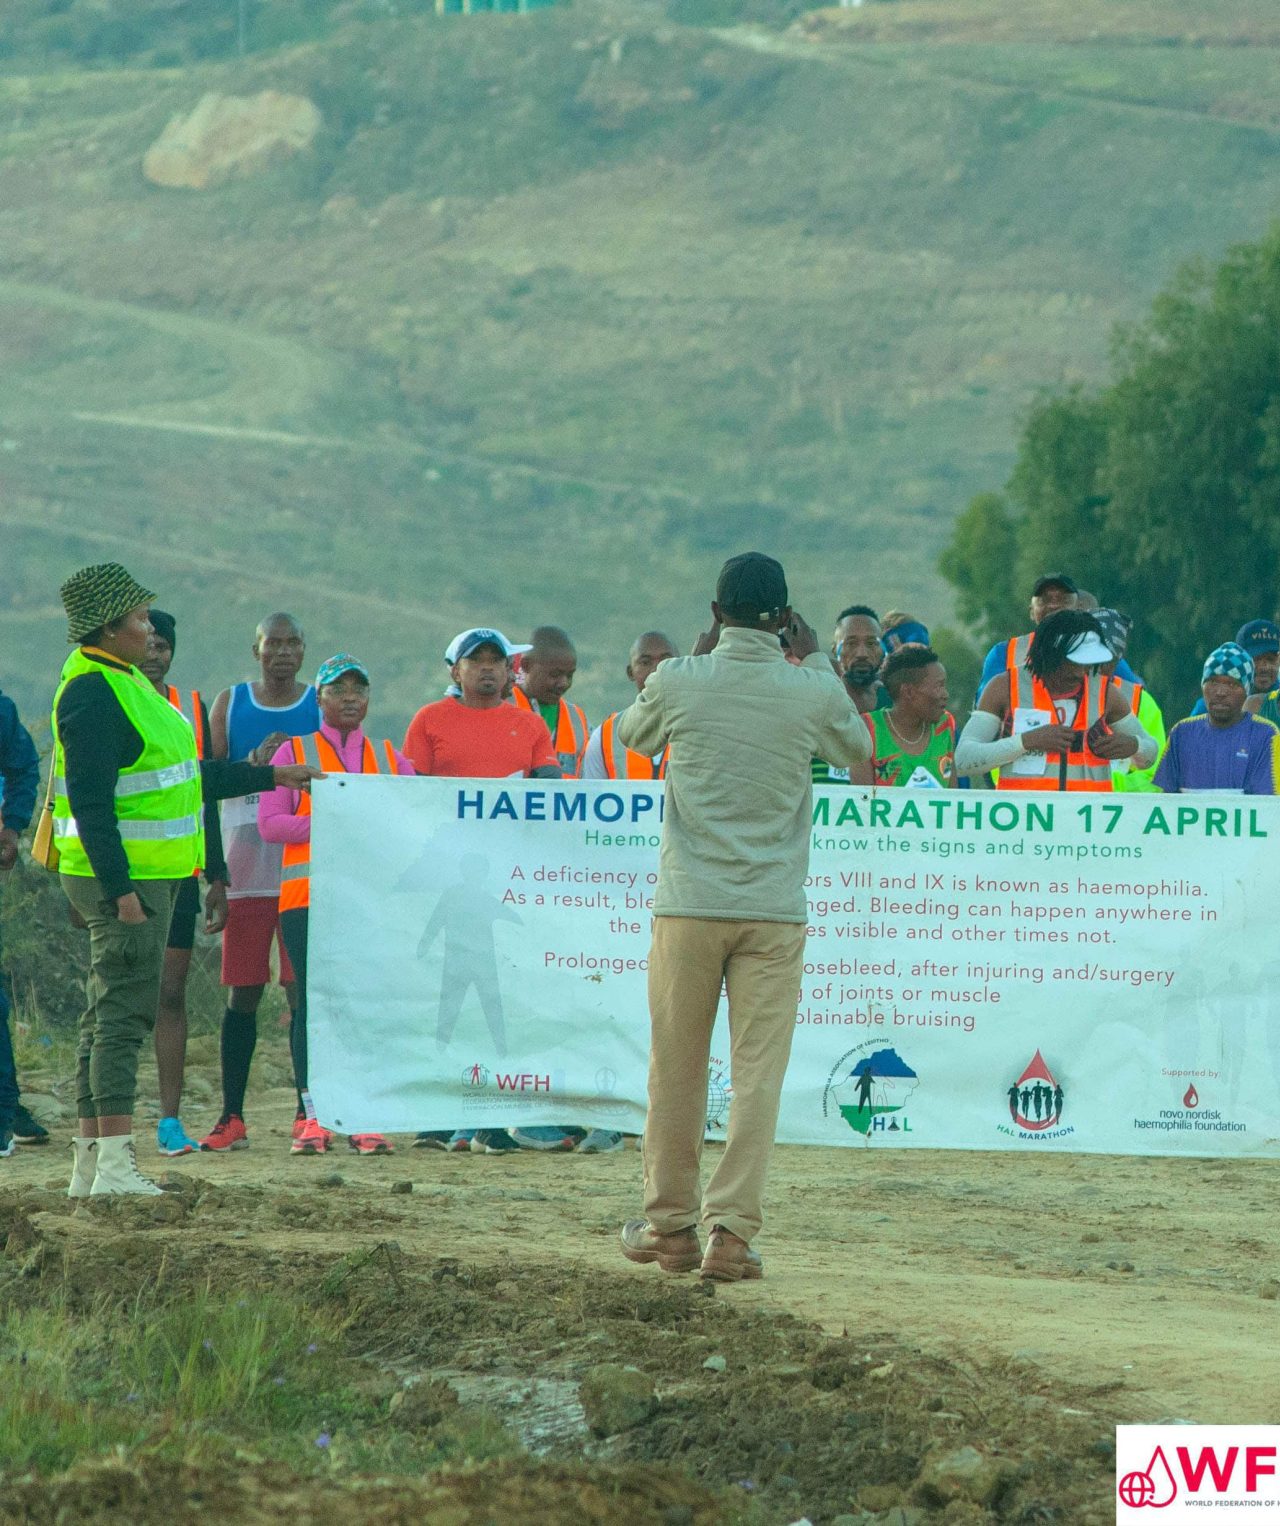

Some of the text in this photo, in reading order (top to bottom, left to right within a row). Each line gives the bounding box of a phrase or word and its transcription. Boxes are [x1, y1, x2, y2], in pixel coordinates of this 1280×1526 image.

[457, 790, 664, 823] HAEMOP
[1076, 804, 1124, 834] 17
[1142, 806, 1268, 838] APRIL
[585, 830, 1143, 861] Haemo know the signs and symptoms
[511, 865, 1208, 899] A deficiency o ors VIII and IX is known as haemophilia.
[502, 888, 527, 905] As
[534, 894, 545, 905] a
[553, 890, 616, 911] result,
[625, 892, 655, 909] ble
[870, 897, 960, 921] Bleeding
[968, 903, 1001, 917] can
[1010, 901, 1086, 922] happen
[1095, 903, 1192, 924] anywhere
[1200, 906, 1218, 921] in
[609, 916, 641, 933] the
[806, 924, 827, 937] es
[835, 921, 898, 938] visible
[906, 924, 943, 940] and
[951, 925, 1006, 942] other
[1014, 927, 1069, 943] times
[1077, 930, 1117, 944] not.
[802, 958, 902, 978] osebleed,
[911, 960, 959, 977] after
[967, 962, 1044, 983] injuring
[1052, 963, 1175, 987] and/surgery
[812, 983, 832, 999] of
[838, 984, 894, 1004] joints
[902, 988, 923, 1001] or
[931, 985, 1001, 1002] muscle
[894, 1008, 976, 1032] bruising
[496, 1074, 550, 1092] WFH
[1161, 1067, 1204, 1078] Supported
[1134, 1119, 1247, 1132] haemophilia foundation
[1159, 1109, 1222, 1120] novo nordisk
[996, 1124, 1075, 1140] HAL MARATHON
